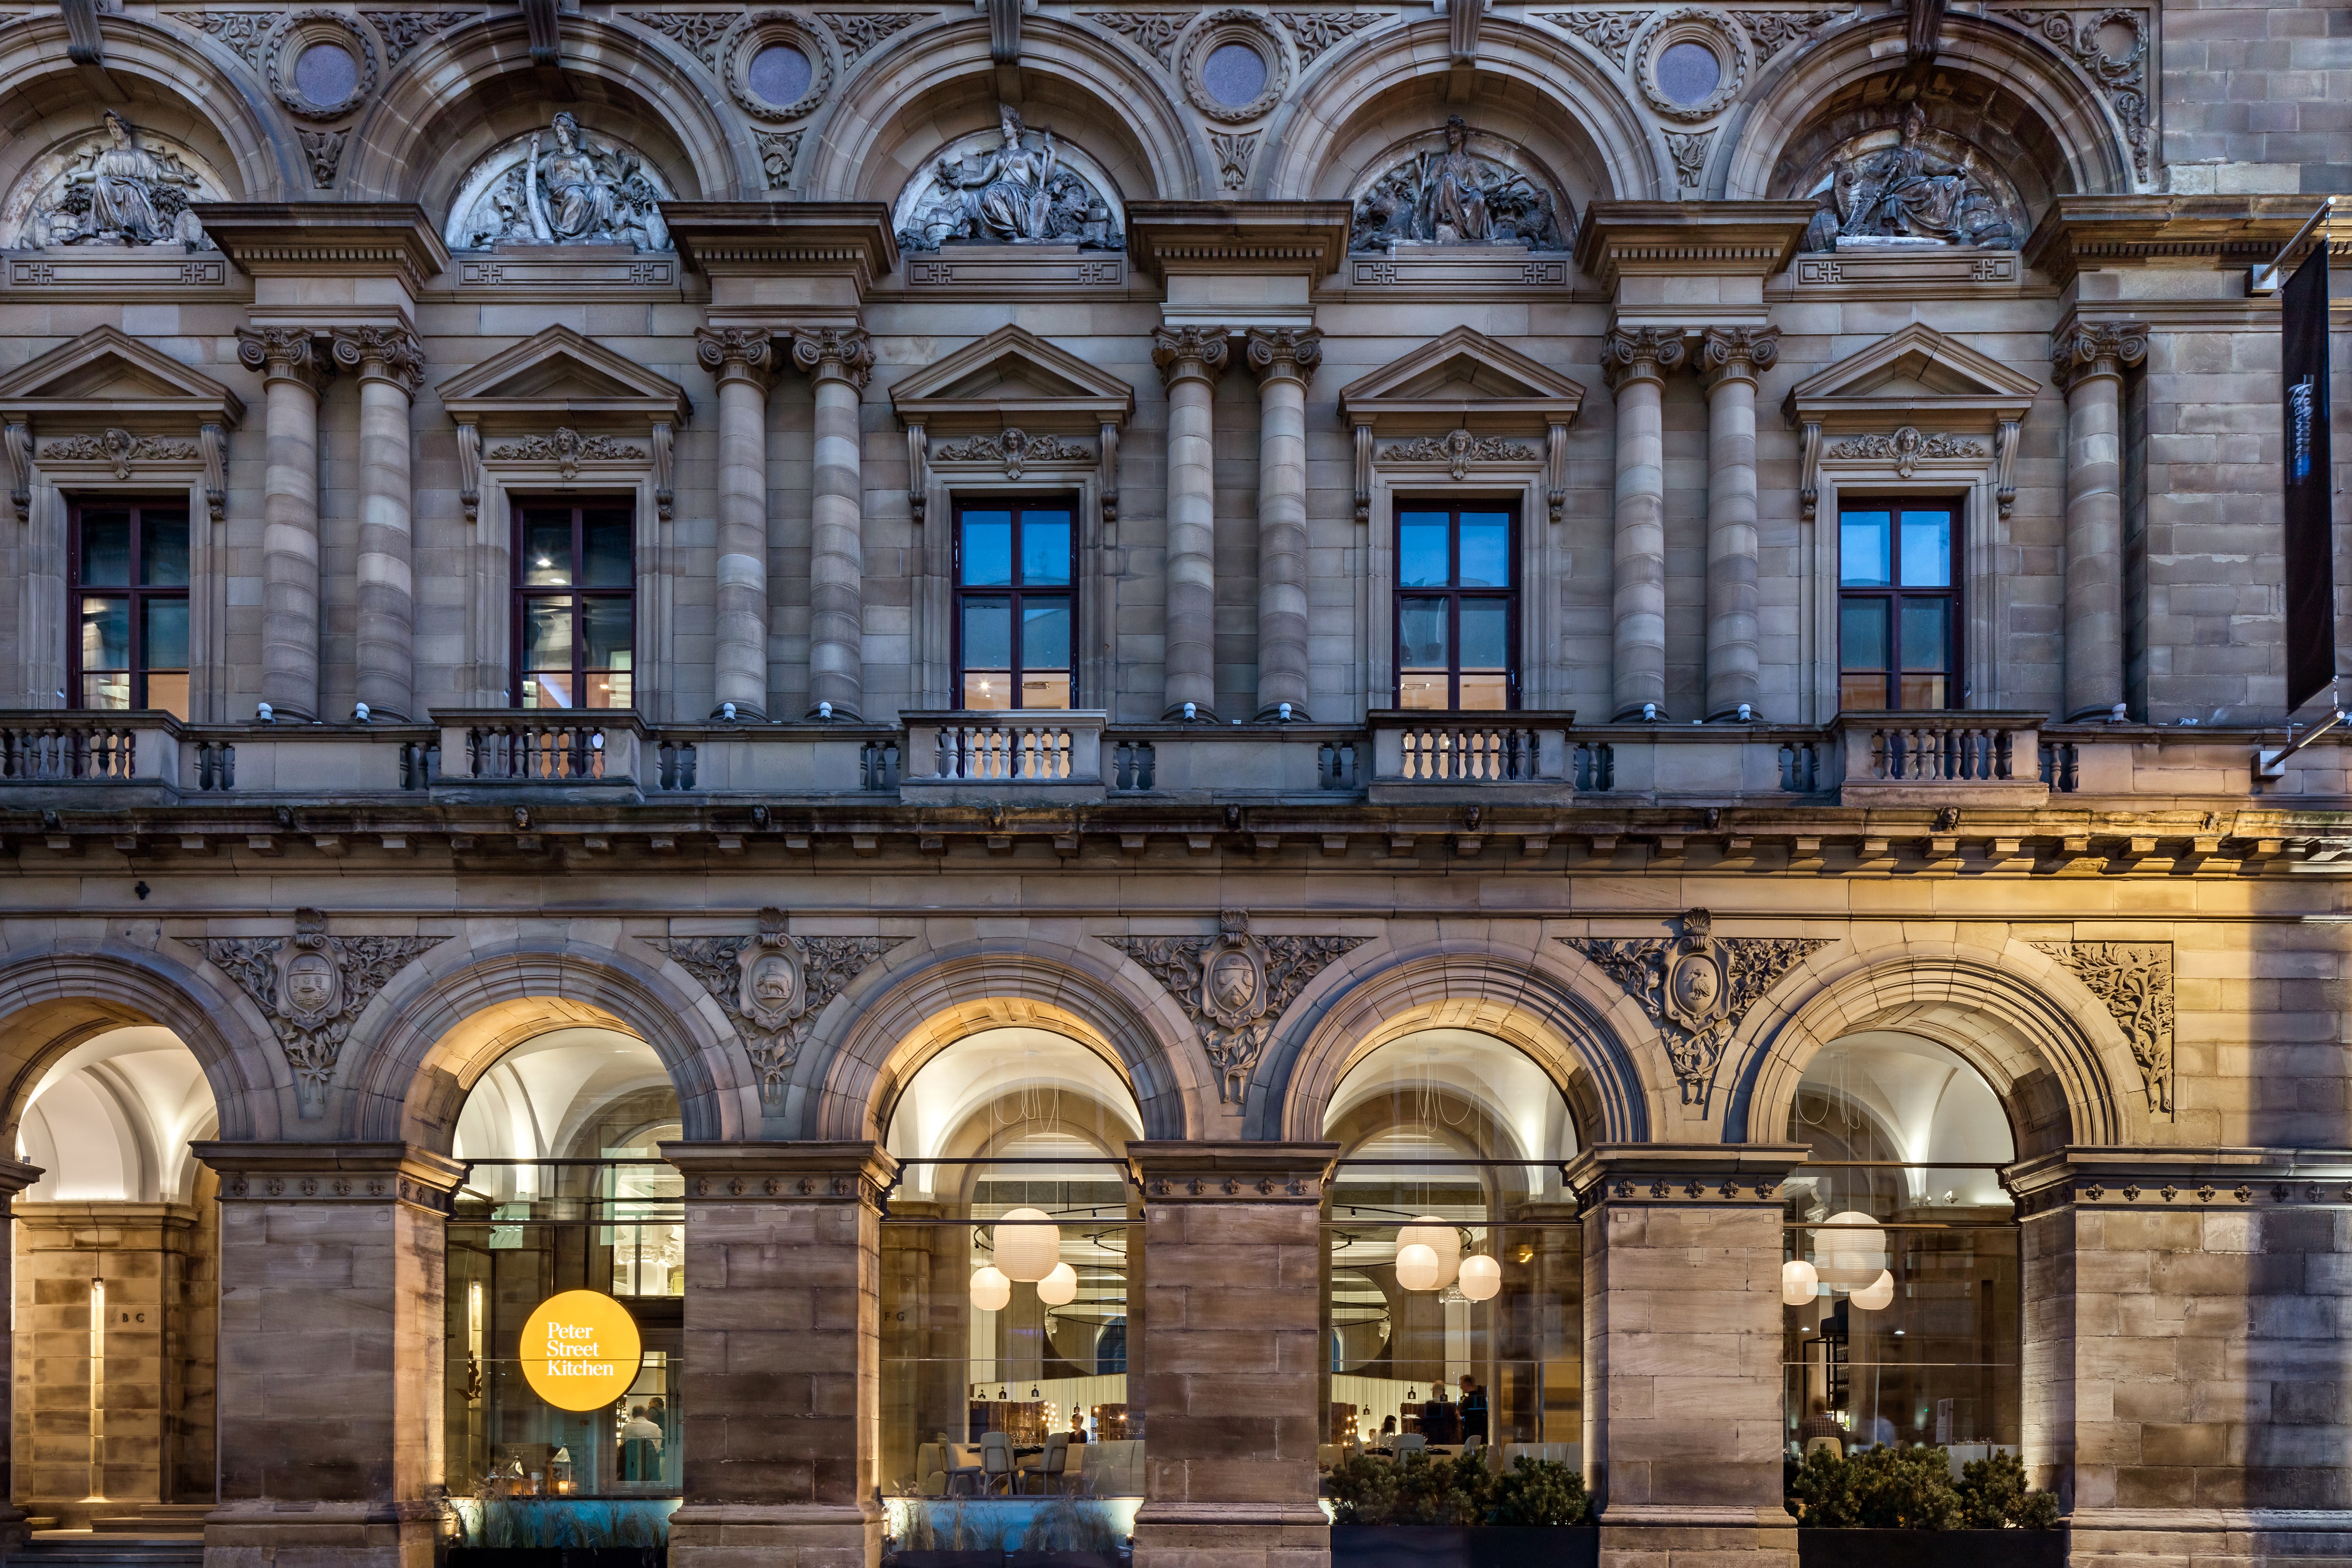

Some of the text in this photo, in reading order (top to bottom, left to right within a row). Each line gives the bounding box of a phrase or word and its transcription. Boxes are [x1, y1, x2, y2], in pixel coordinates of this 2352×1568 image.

[942, 196, 961, 209] OTTON
[122, 1313, 144, 1322] B C
[884, 1312, 905, 1321] F G
[547, 1322, 594, 1338] Peter
[547, 1340, 600, 1357] Street
[547, 1360, 614, 1376] Kitchen
